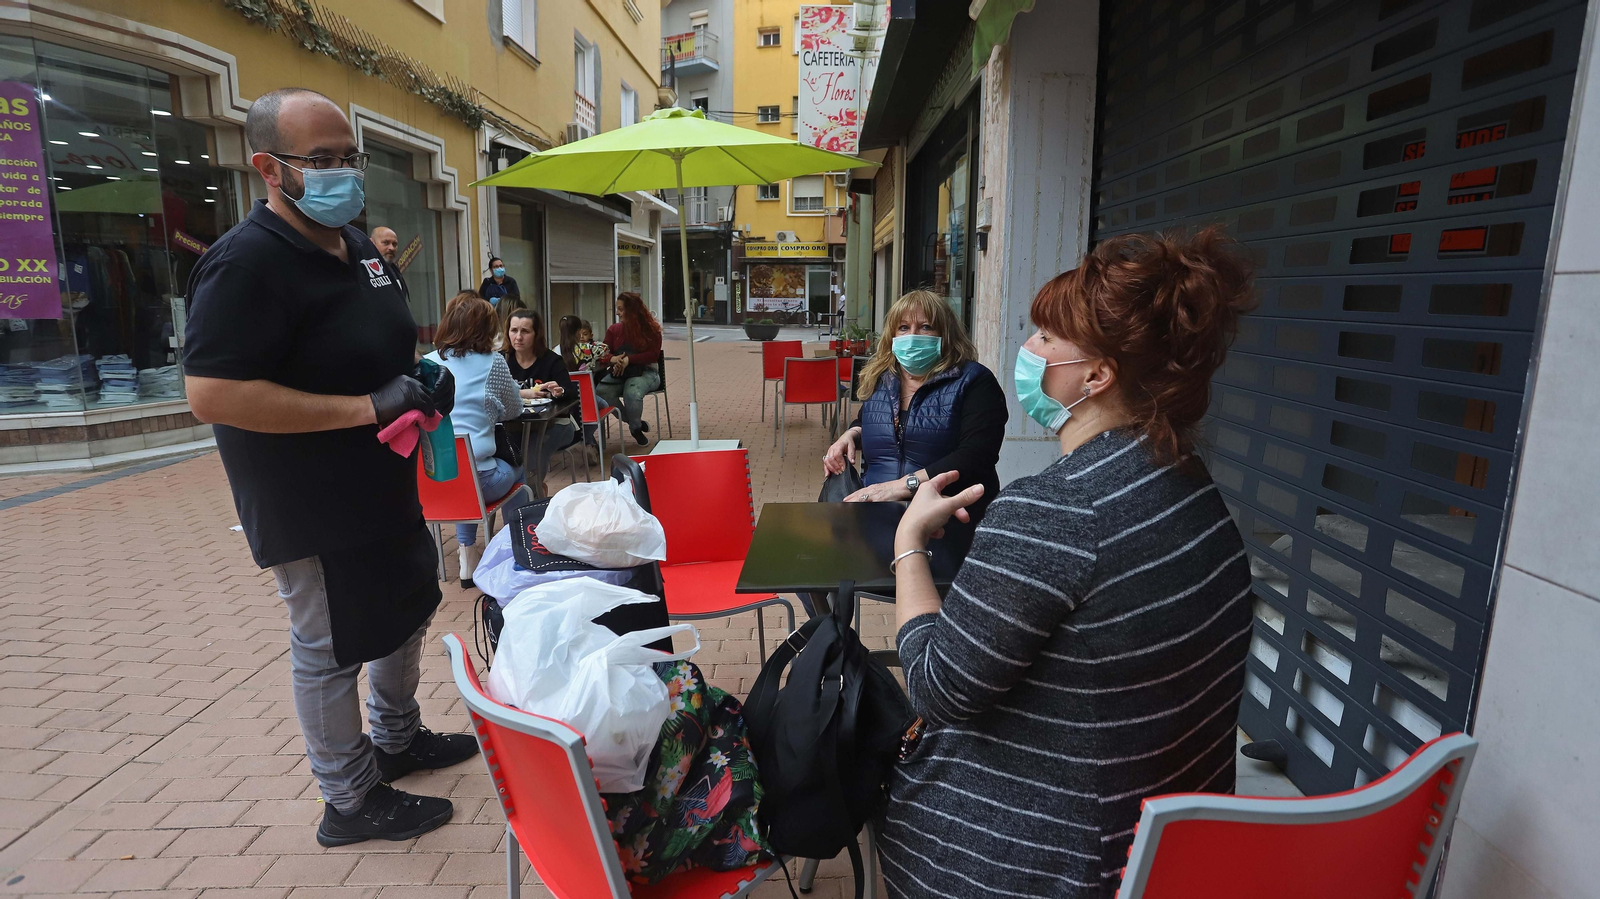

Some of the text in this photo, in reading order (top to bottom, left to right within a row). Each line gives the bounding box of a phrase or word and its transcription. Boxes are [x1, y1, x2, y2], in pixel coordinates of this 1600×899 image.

[1456, 125, 1506, 149] NDE
[1, 171, 40, 182] vida a
[27, 186, 41, 195] de
[174, 231, 201, 251] Precios
[15, 258, 49, 273] XX
